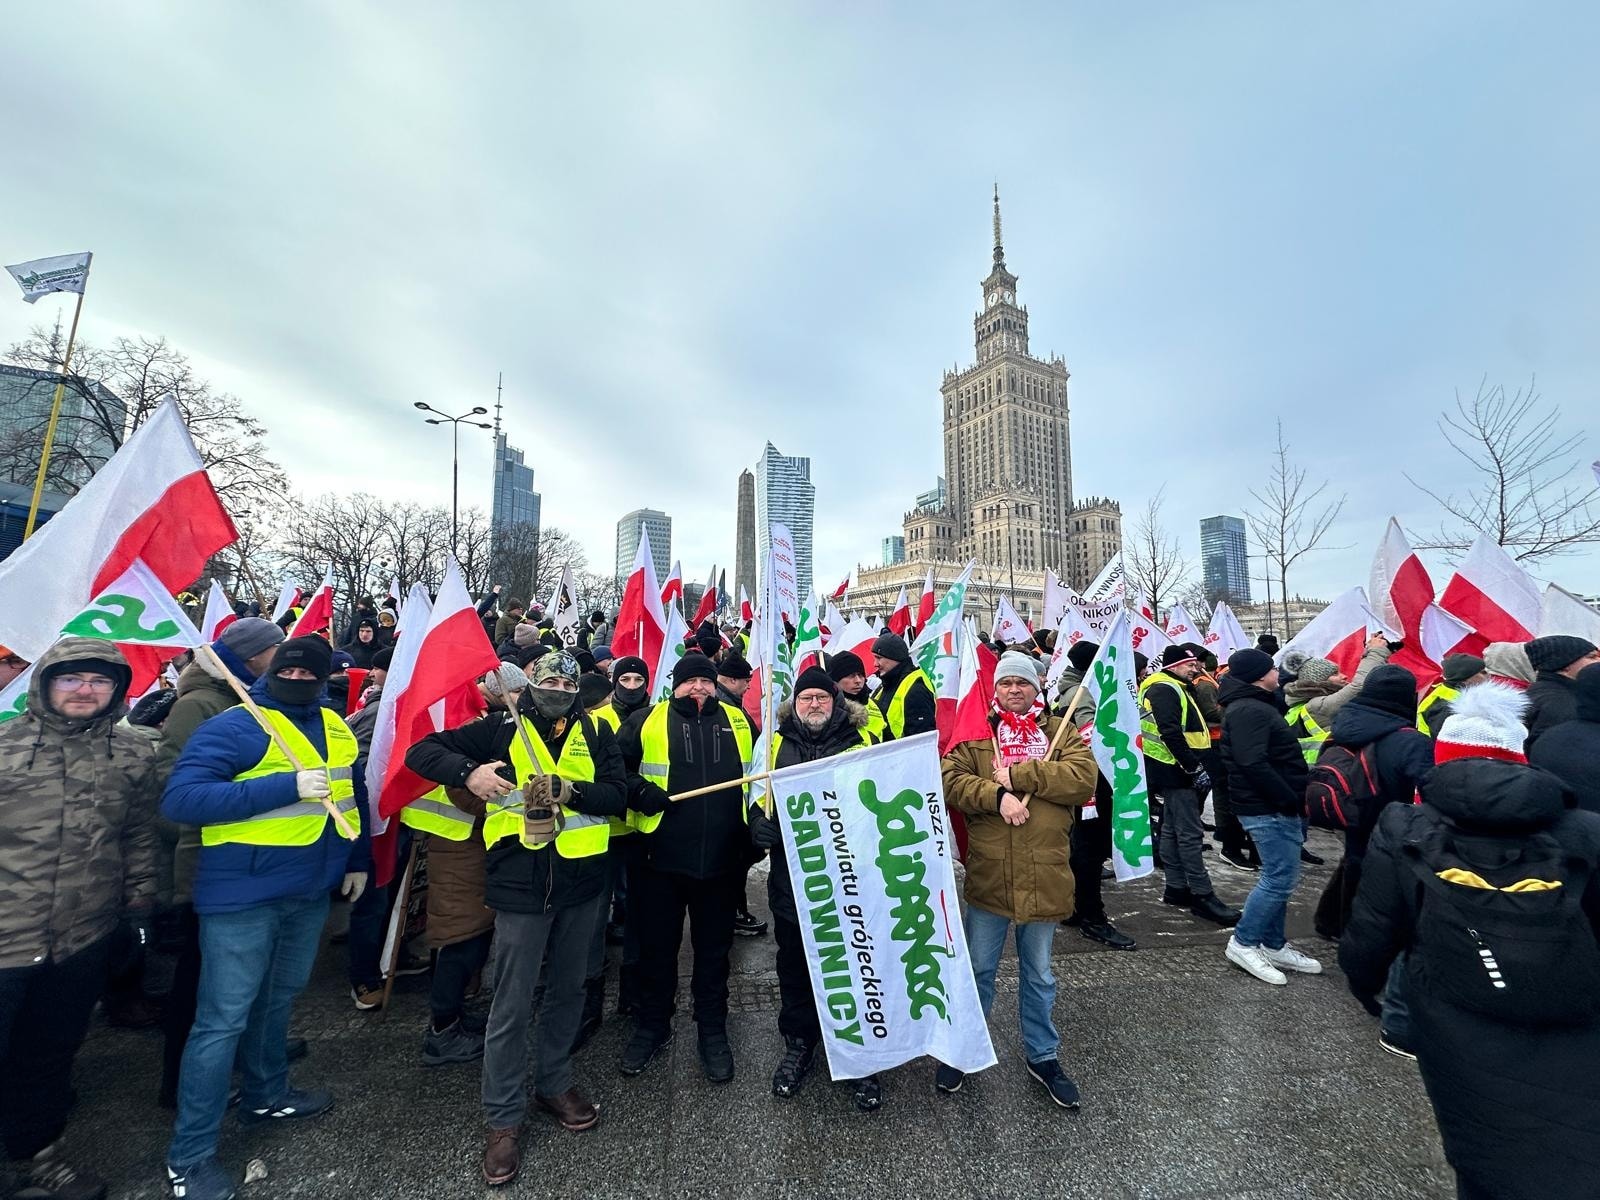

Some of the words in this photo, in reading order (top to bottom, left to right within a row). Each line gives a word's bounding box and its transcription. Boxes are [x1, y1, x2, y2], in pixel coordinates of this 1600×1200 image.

[822, 790, 838, 801] z
[925, 791, 944, 836] NSZZ
[822, 807, 860, 897] powiatu
[786, 791, 865, 1047] SADOWNICY
[843, 903, 888, 1039] grójeckiego
